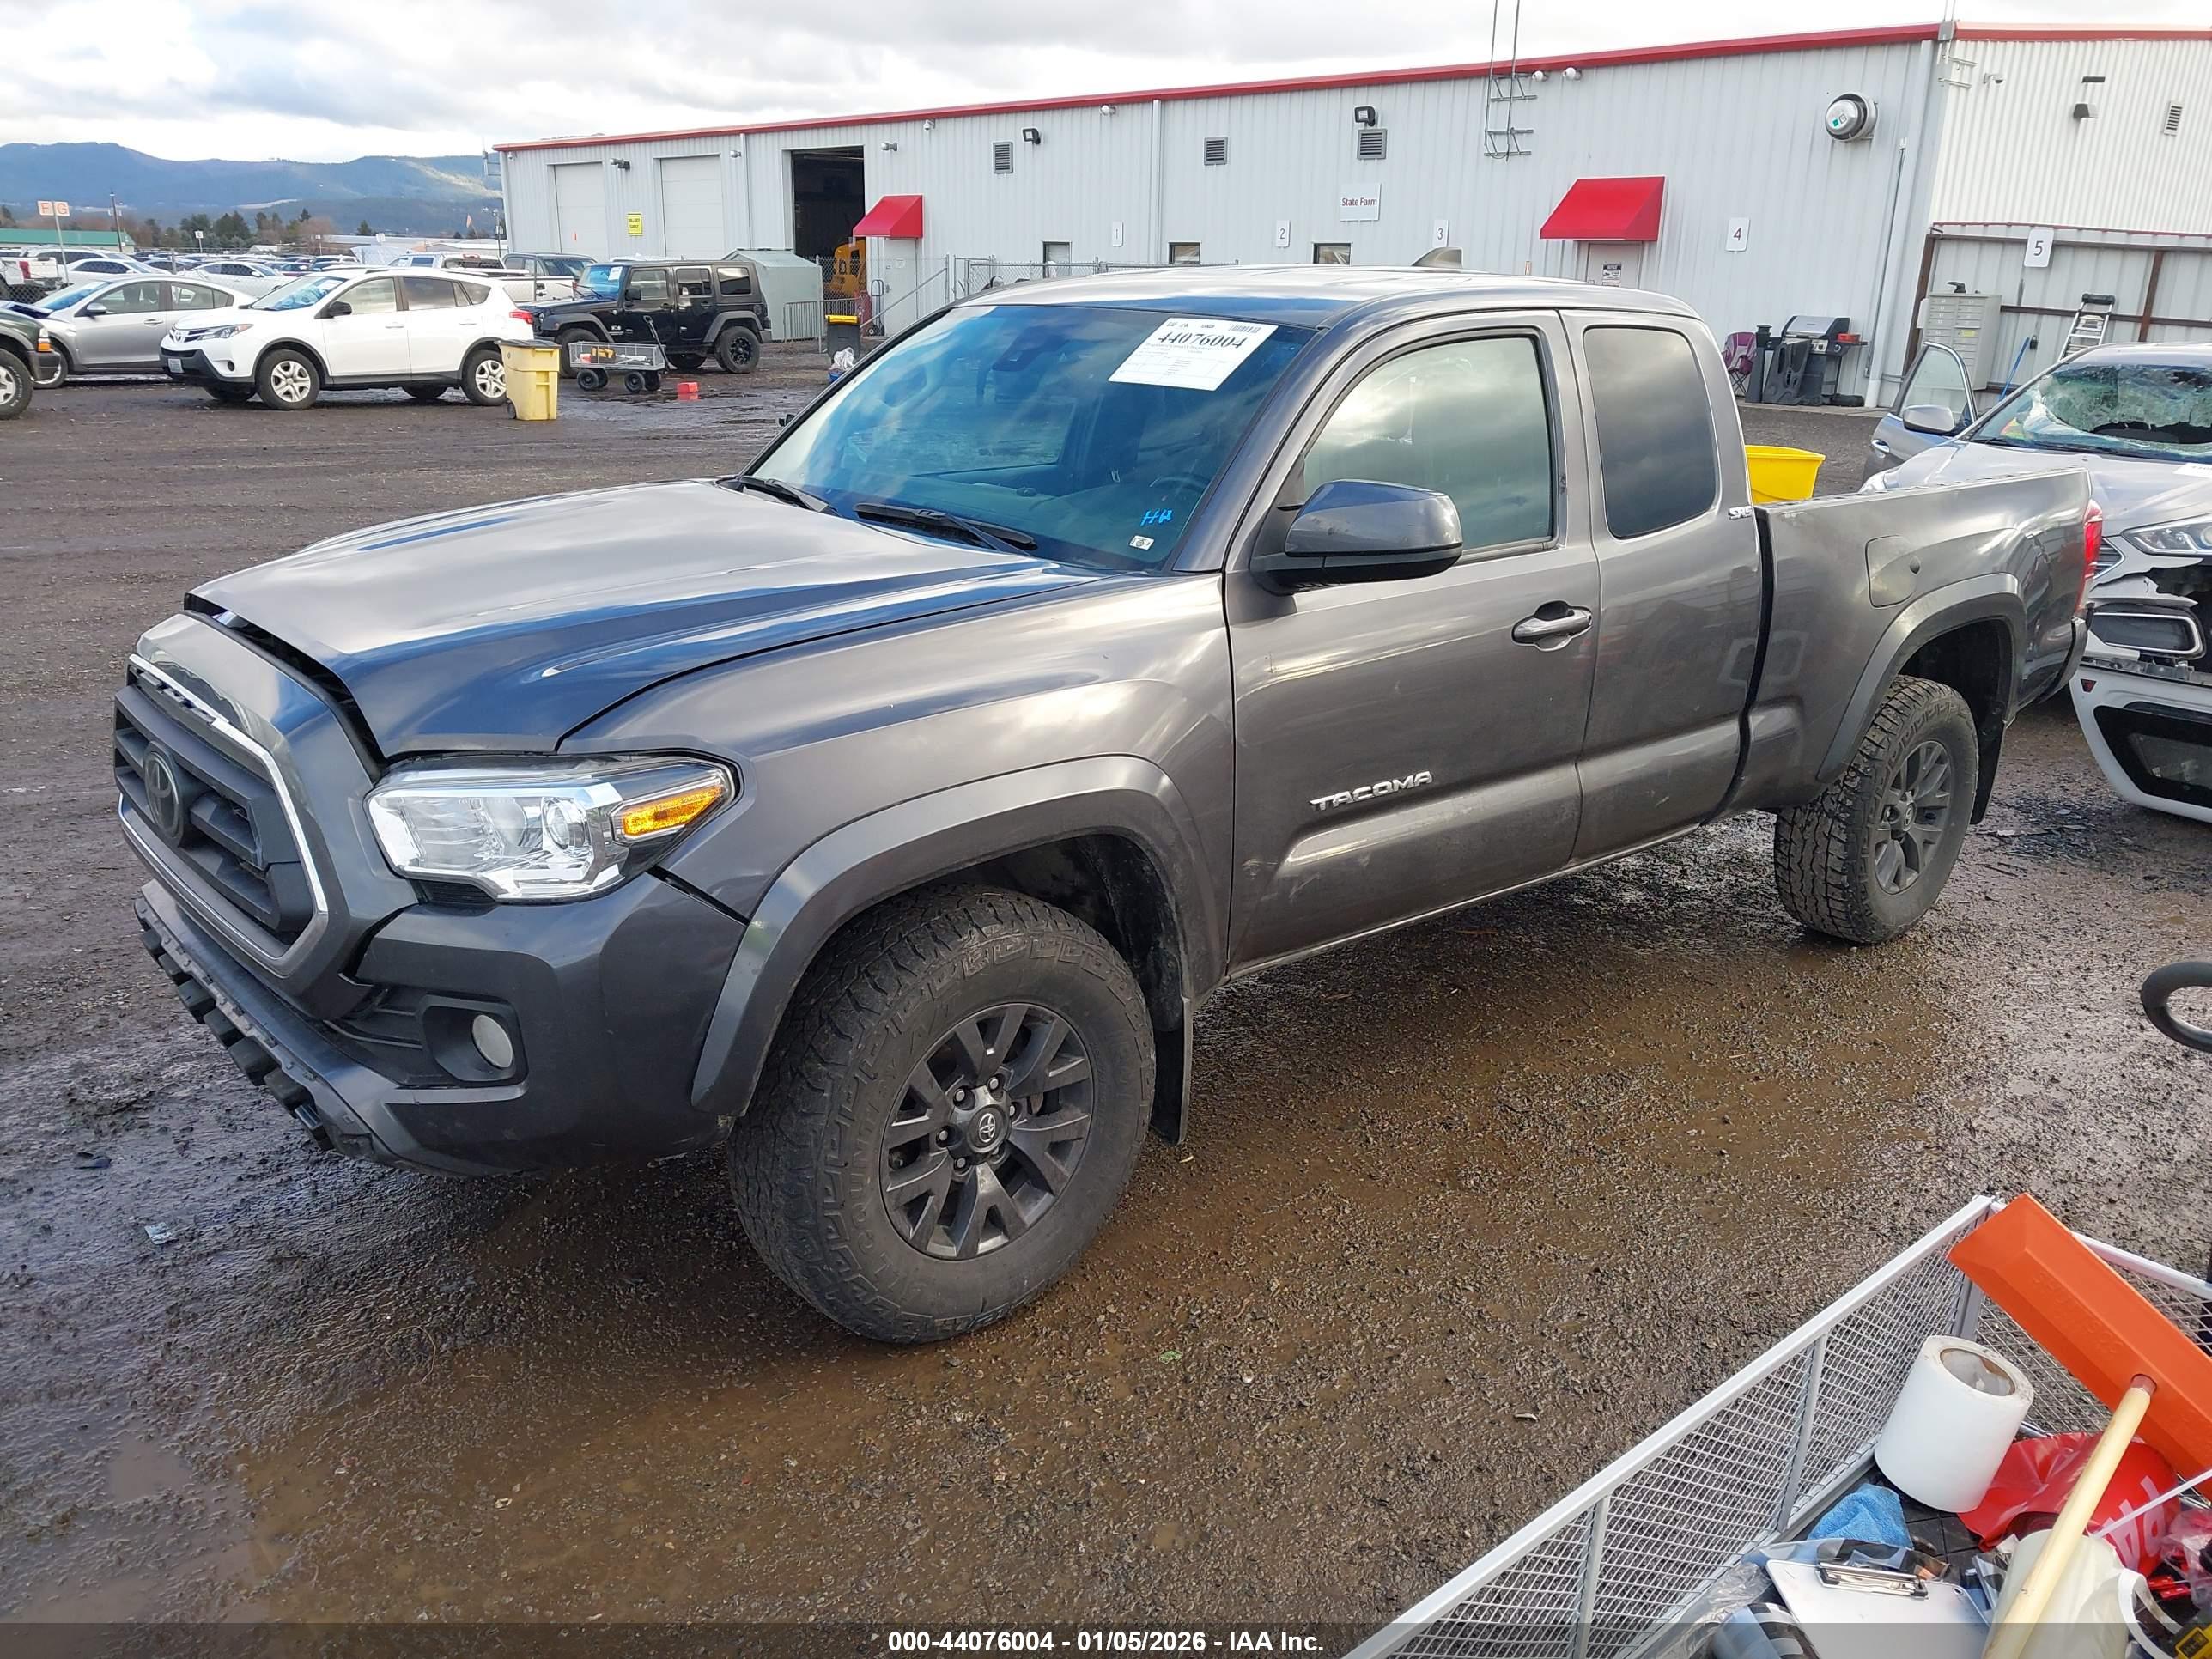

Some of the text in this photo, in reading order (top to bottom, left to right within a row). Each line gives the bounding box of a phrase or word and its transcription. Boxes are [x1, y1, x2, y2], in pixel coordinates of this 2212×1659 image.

[40, 202, 50, 214] F
[1341, 197, 1377, 207] State Farm
[57, 203, 68, 215] G
[1279, 228, 1285, 240] 2
[1437, 228, 1443, 240] 3
[1733, 227, 1742, 241] 4
[2033, 240, 2044, 257] 5
[1158, 331, 1248, 349] 44076004
[1309, 770, 1433, 811] TACOMA
